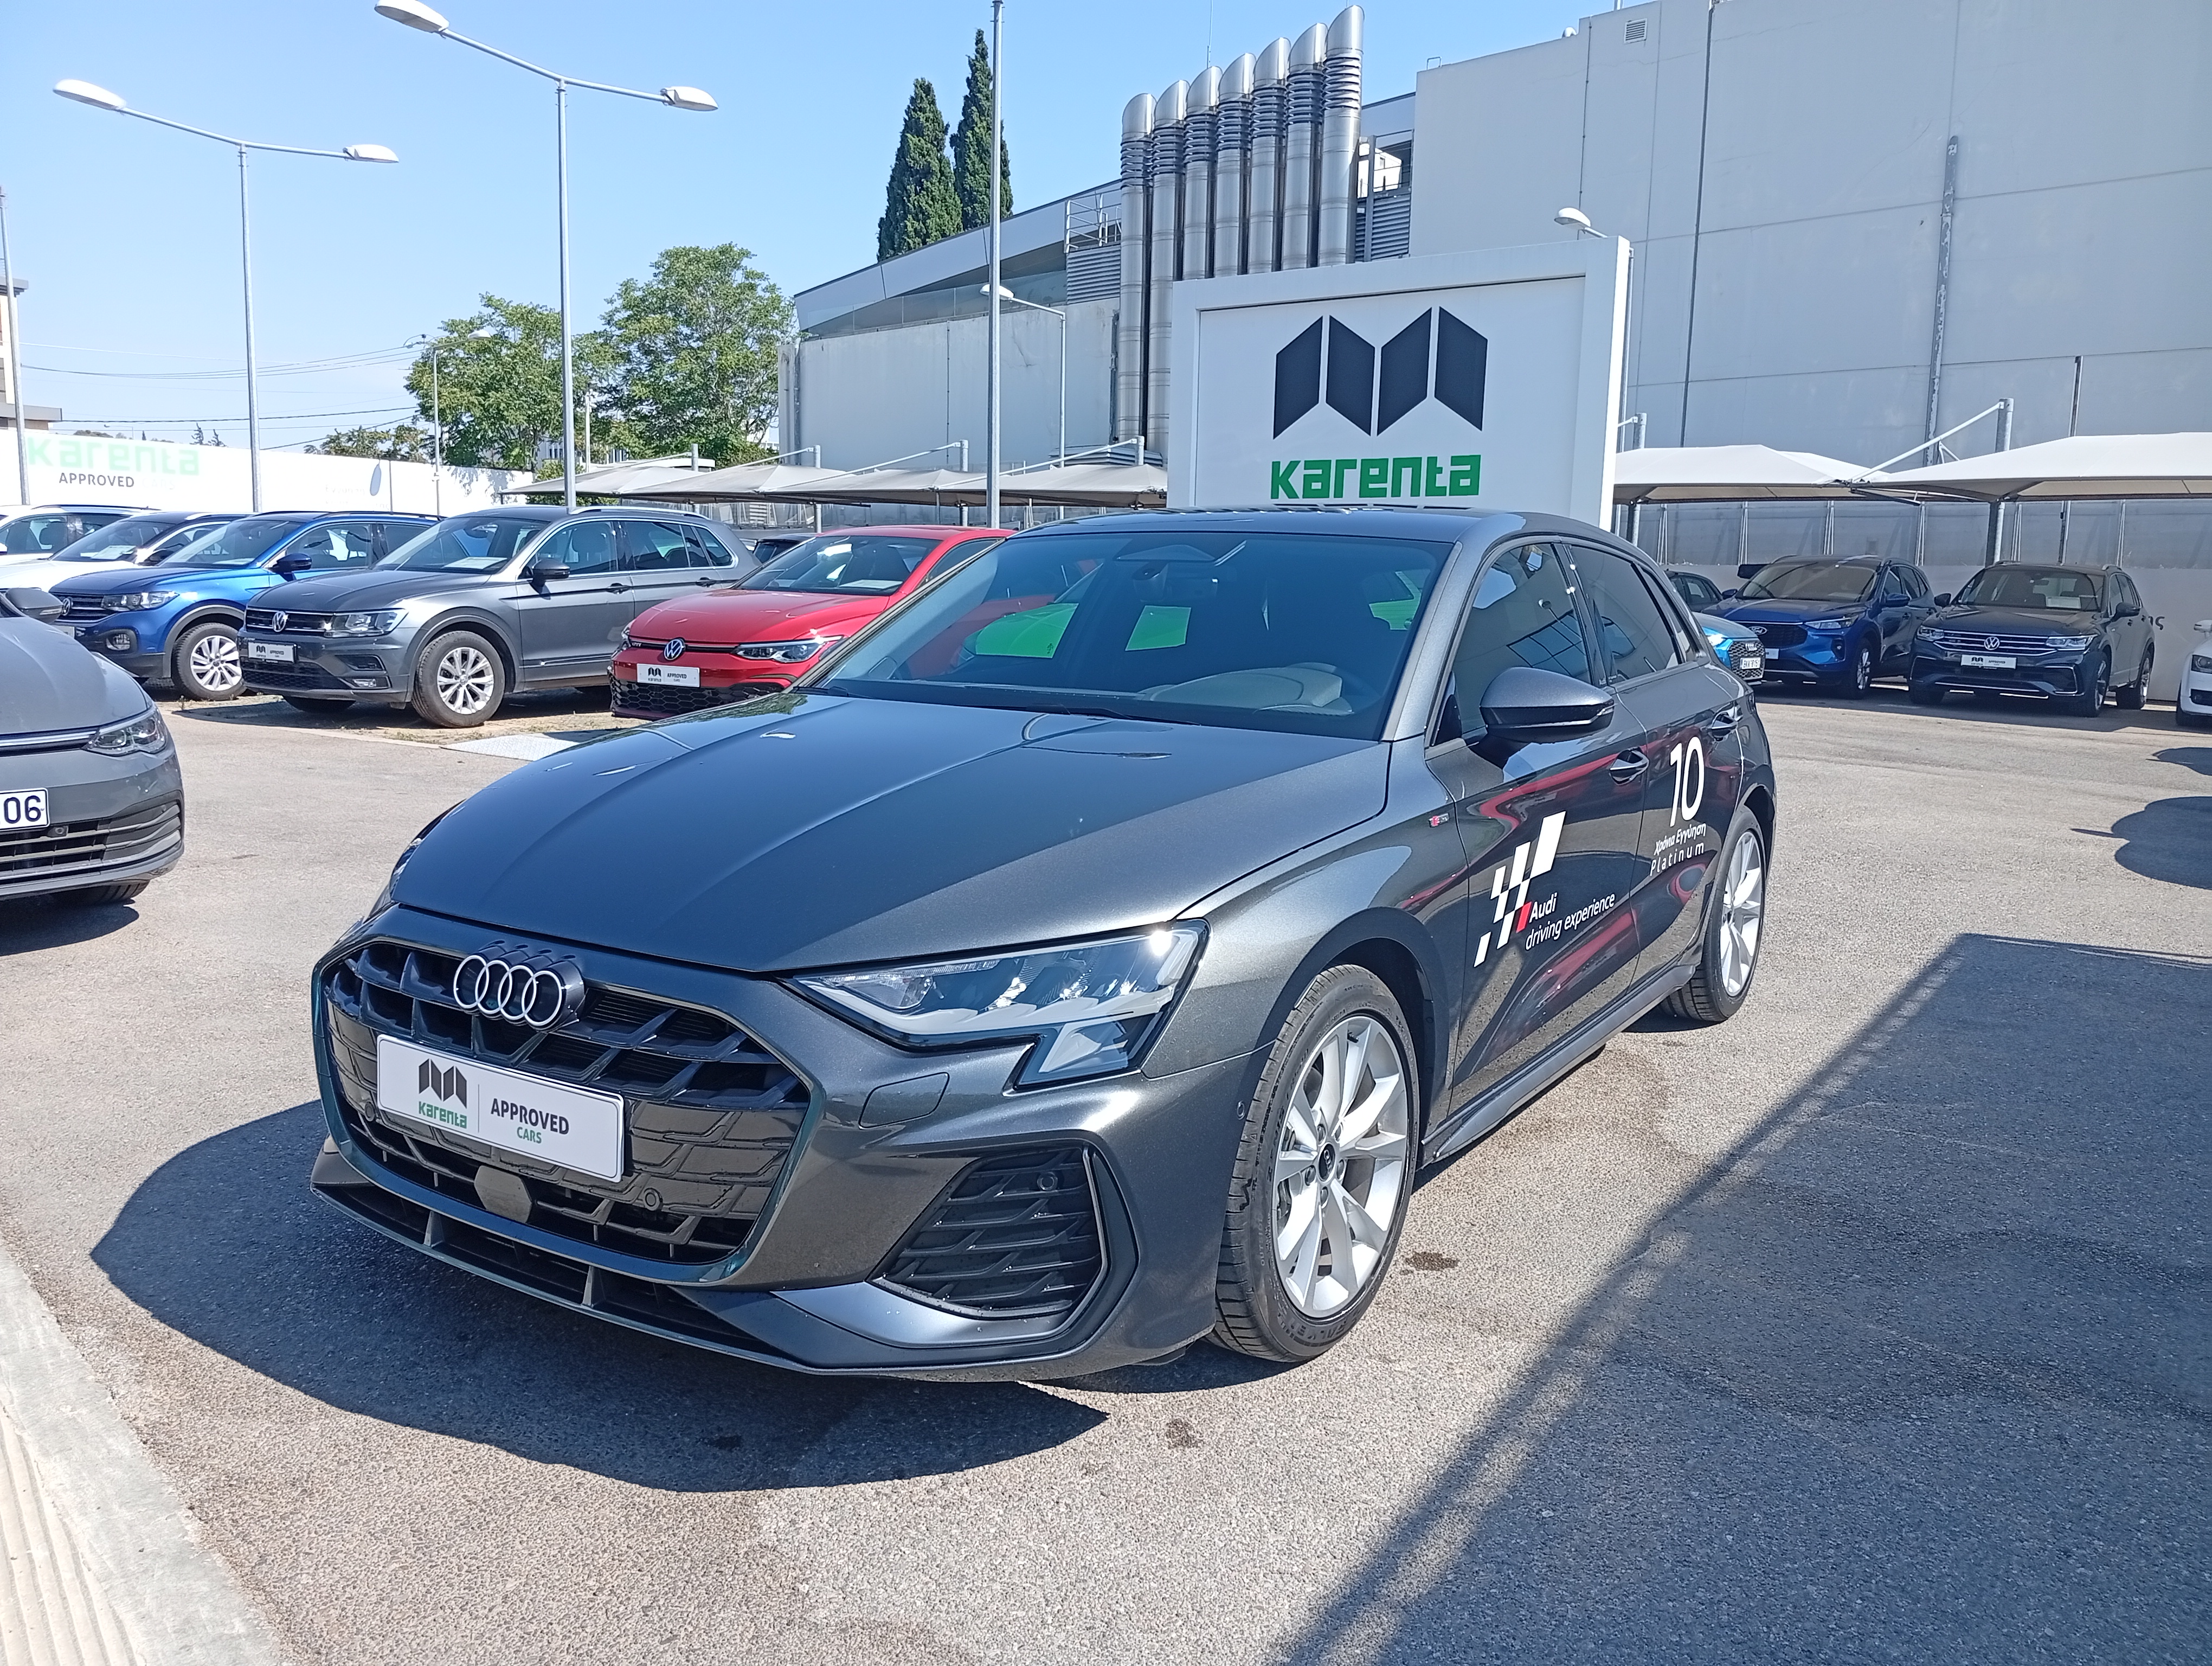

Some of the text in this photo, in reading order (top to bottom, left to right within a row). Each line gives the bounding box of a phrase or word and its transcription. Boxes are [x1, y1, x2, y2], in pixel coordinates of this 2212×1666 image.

[28, 437, 200, 476] karenta
[59, 472, 134, 488] APPROVED
[1270, 454, 1481, 499] karenta
[1670, 736, 1705, 828] 10
[1653, 823, 1706, 856] Χρόνια Εγγύηση
[1650, 842, 1704, 876] Platinum
[1526, 894, 1615, 950] driving experience
[1529, 892, 1558, 923] Audi
[419, 1101, 467, 1129] karenta
[490, 1098, 569, 1135] APPROVED
[517, 1126, 542, 1144] CARS
